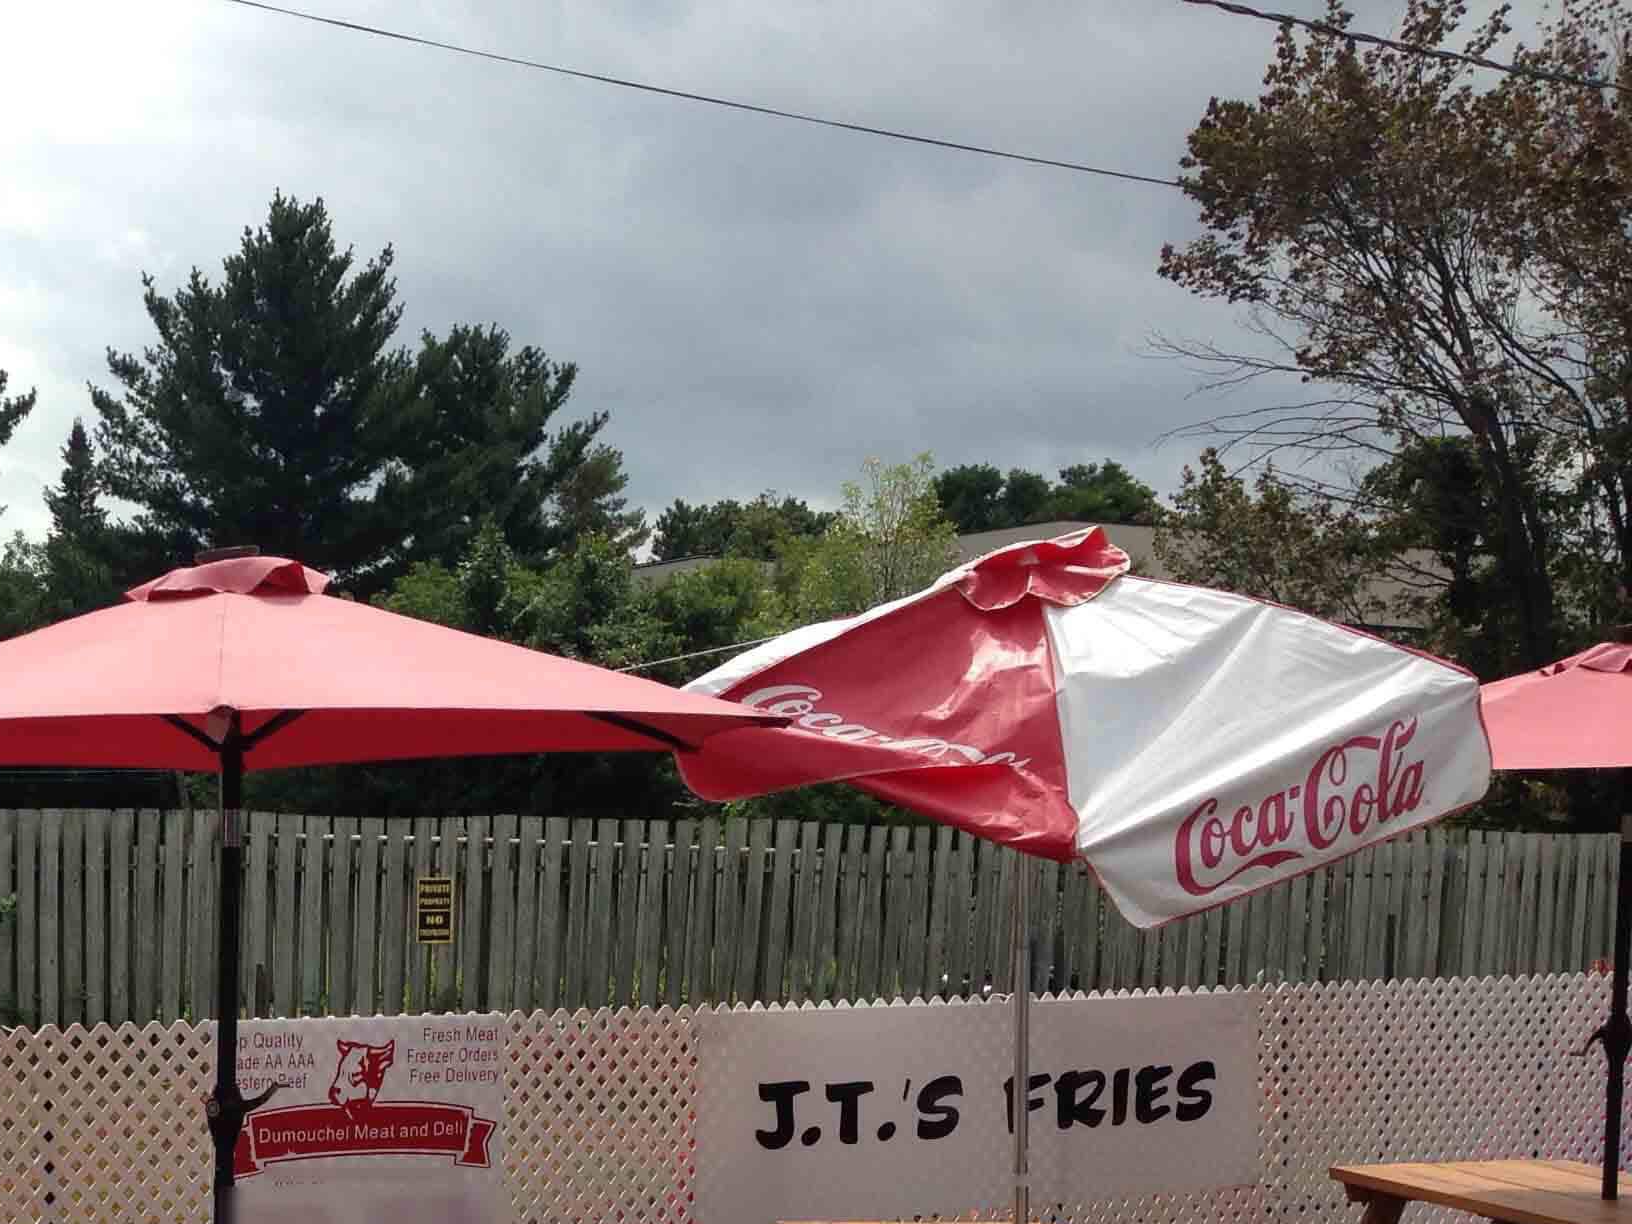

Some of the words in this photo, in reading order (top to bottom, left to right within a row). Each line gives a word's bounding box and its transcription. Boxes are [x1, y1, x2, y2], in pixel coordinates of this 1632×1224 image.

[1174, 713, 1424, 896] Coca-Cola
[425, 914, 445, 926] NO
[253, 1031, 303, 1052] Quality
[423, 1026, 461, 1042] Fresh
[465, 1025, 498, 1041] Meat
[236, 1055, 260, 1070] ade
[264, 1053, 283, 1070] AA
[287, 1052, 315, 1070] AAA
[407, 1048, 454, 1064] Freezer
[459, 1046, 499, 1062] Orders
[236, 1073, 273, 1089] estern
[409, 1068, 441, 1084] Free
[446, 1066, 500, 1083] Delivery
[754, 1074, 964, 1150] J.T.'S
[1003, 1060, 1217, 1134] FRIES
[258, 1126, 349, 1144] Dumouchel
[354, 1124, 395, 1140] Meat
[399, 1121, 428, 1137] and
[433, 1120, 463, 1137] Deli
